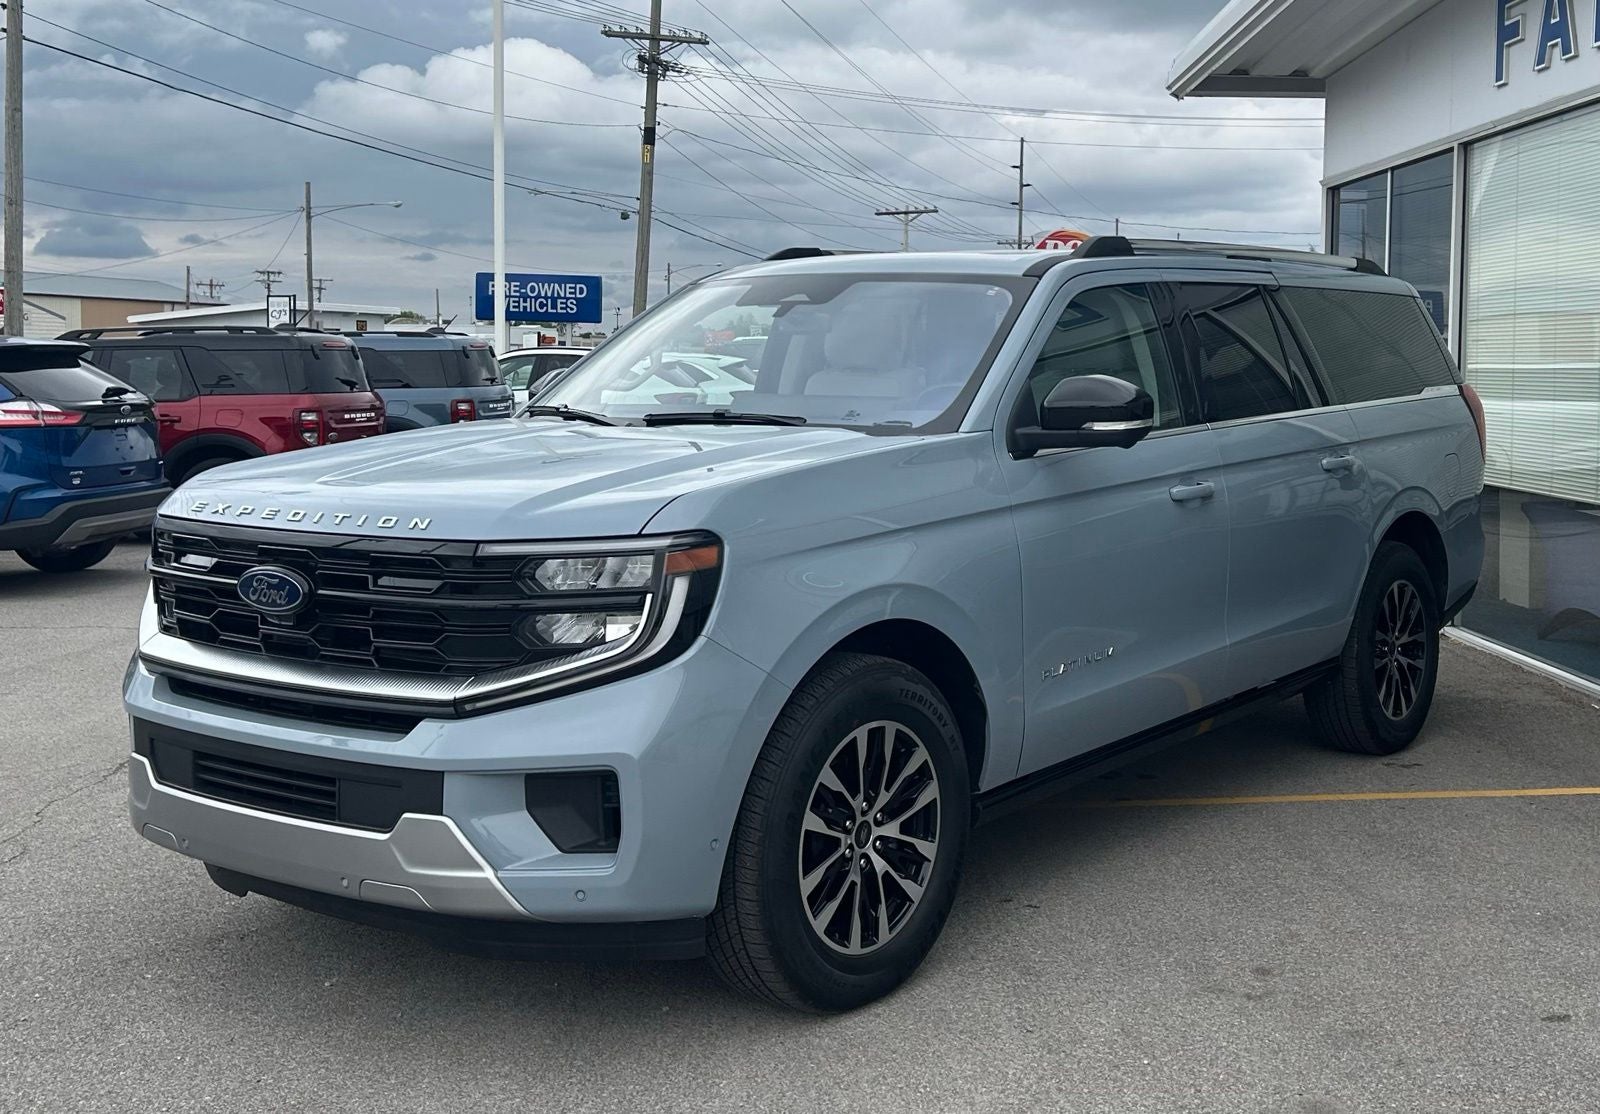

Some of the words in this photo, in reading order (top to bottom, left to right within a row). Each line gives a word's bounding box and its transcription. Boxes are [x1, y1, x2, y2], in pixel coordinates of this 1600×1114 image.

[1494, 0, 1600, 87] FA
[191, 501, 432, 530] EXPEDITION
[250, 575, 288, 605] Ford
[899, 688, 949, 729] TERRITORY
